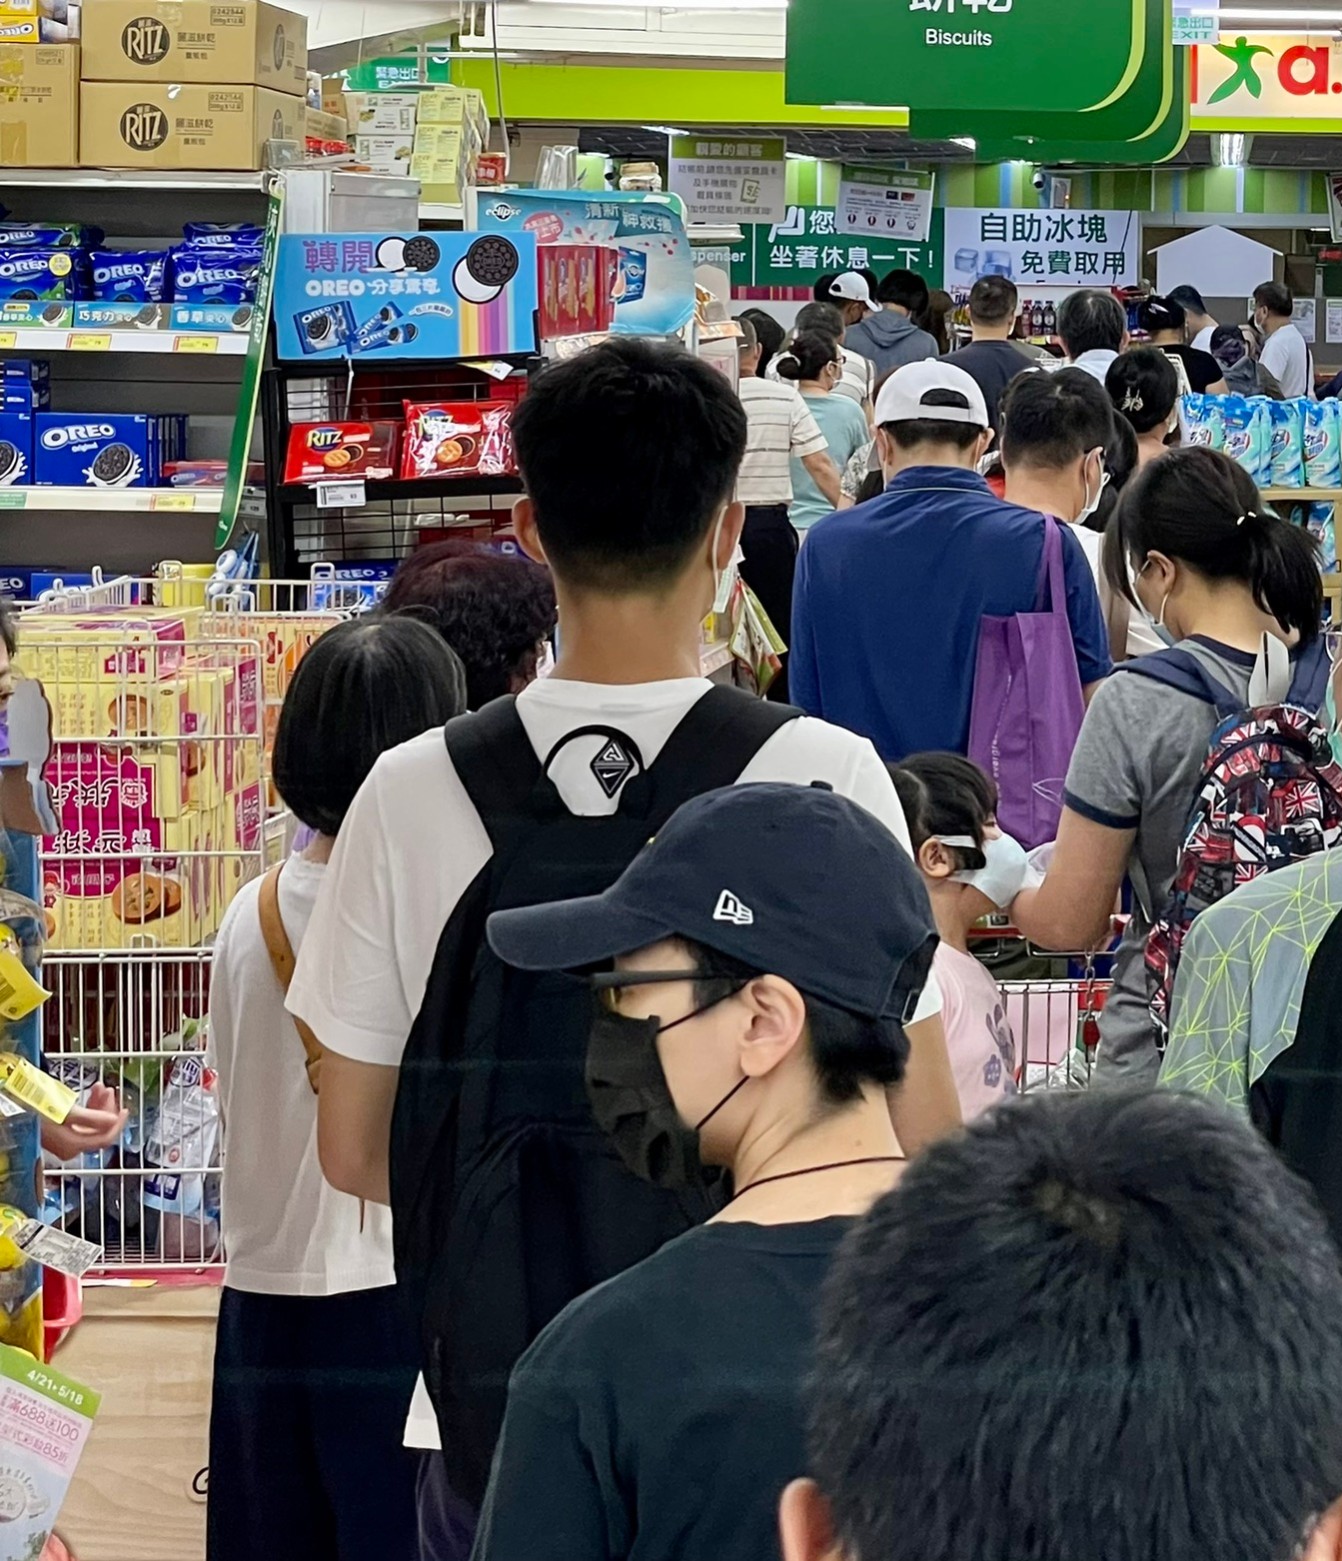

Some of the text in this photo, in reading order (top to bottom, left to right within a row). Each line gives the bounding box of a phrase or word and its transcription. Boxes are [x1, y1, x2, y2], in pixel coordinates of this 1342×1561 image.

[127, 26, 163, 58] RITZ
[925, 29, 992, 47] Biscuits
[126, 112, 161, 144] RITZ
[486, 207, 521, 219] eclipse
[981, 212, 1107, 242] 自助冰塊
[303, 241, 373, 273] 轉開
[770, 246, 933, 268] 坐著休息一下!
[1021, 250, 1125, 275] 免費取用
[0, 260, 47, 276] OREO
[94, 264, 144, 283] OREO
[177, 269, 238, 288] OREO
[306, 280, 365, 296] OREO
[79, 311, 133, 323] 巧克力夾心
[177, 311, 226, 324] 香草夾心
[302, 306, 331, 324] OREO
[360, 330, 389, 347] OREO
[43, 424, 115, 447] OREO
[308, 430, 343, 447] RITZ
[71, 443, 98, 452] Original
[27, 1369, 84, 1406] 4/21 5/18
